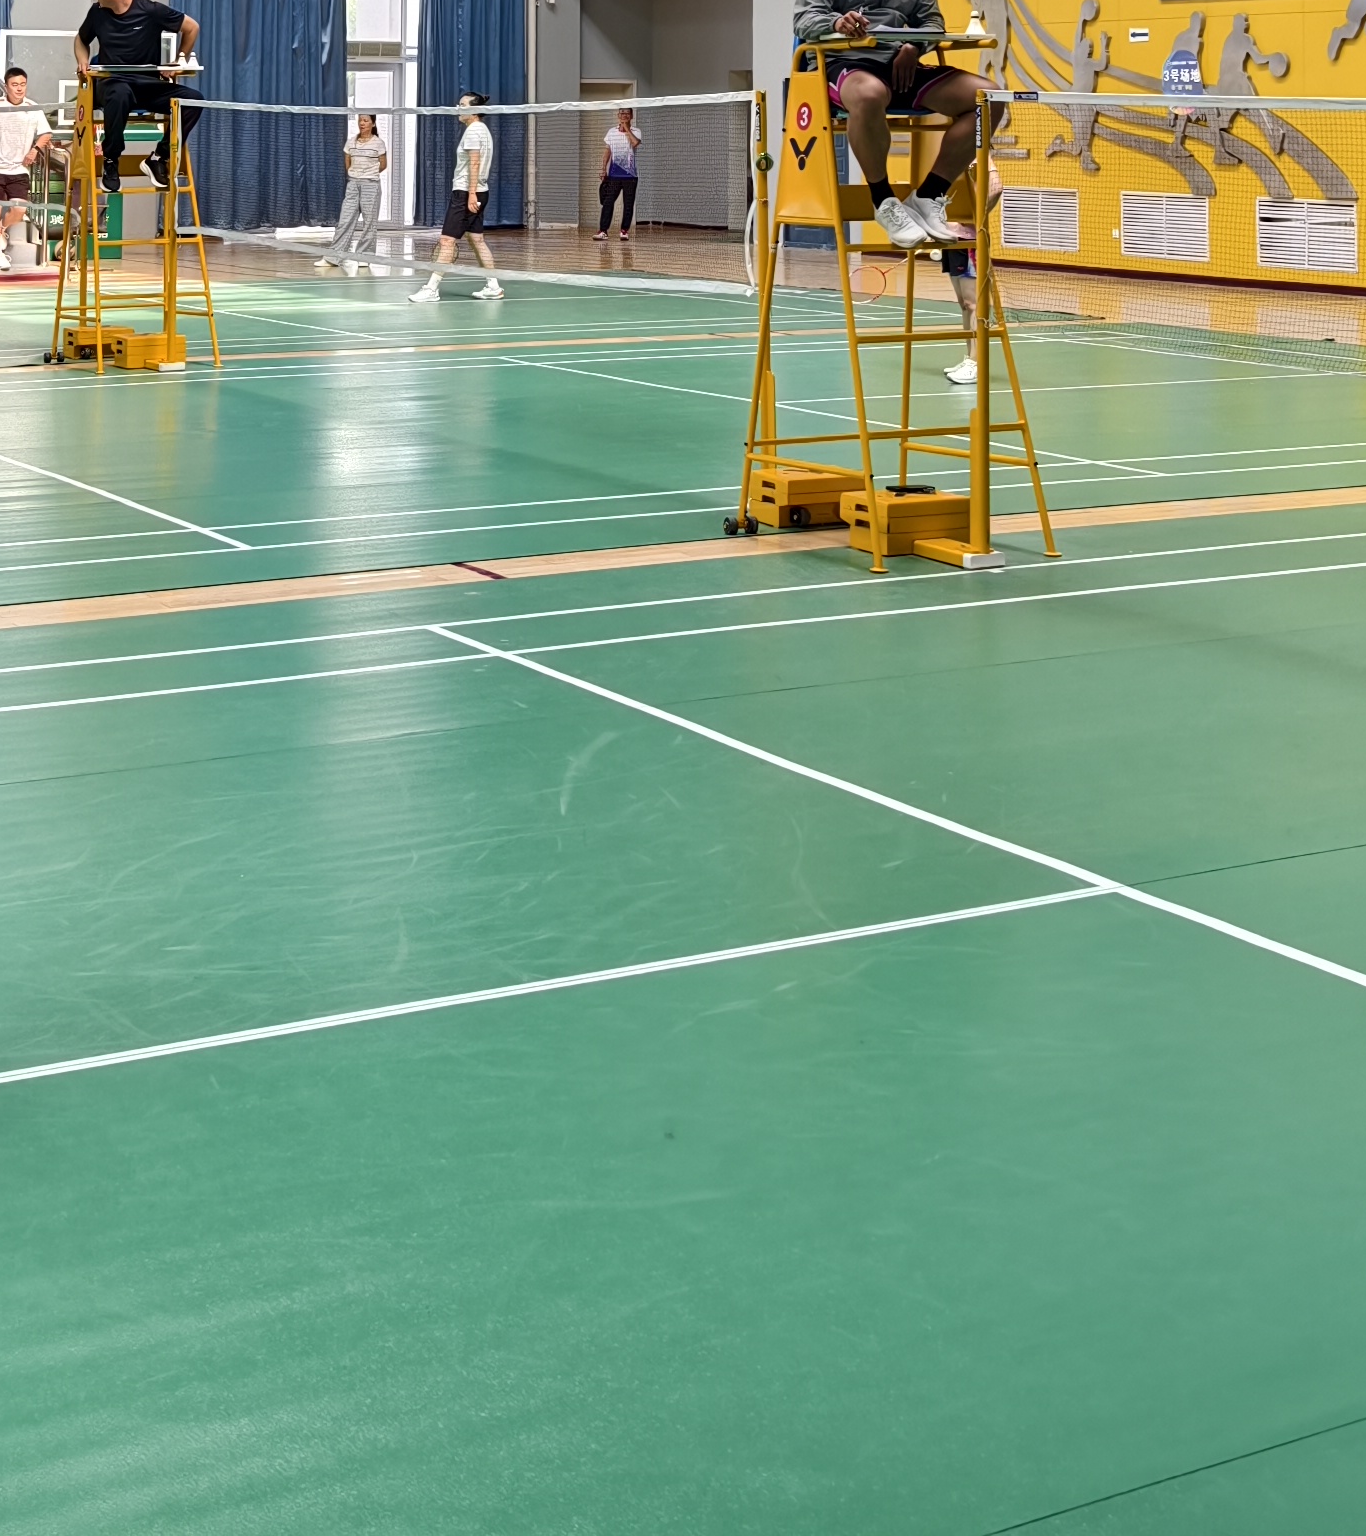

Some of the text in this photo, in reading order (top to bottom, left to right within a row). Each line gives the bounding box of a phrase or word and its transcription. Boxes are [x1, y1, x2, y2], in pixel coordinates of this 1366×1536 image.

[1163, 68, 1202, 83] 3号场地
[800, 106, 809, 127] 3
